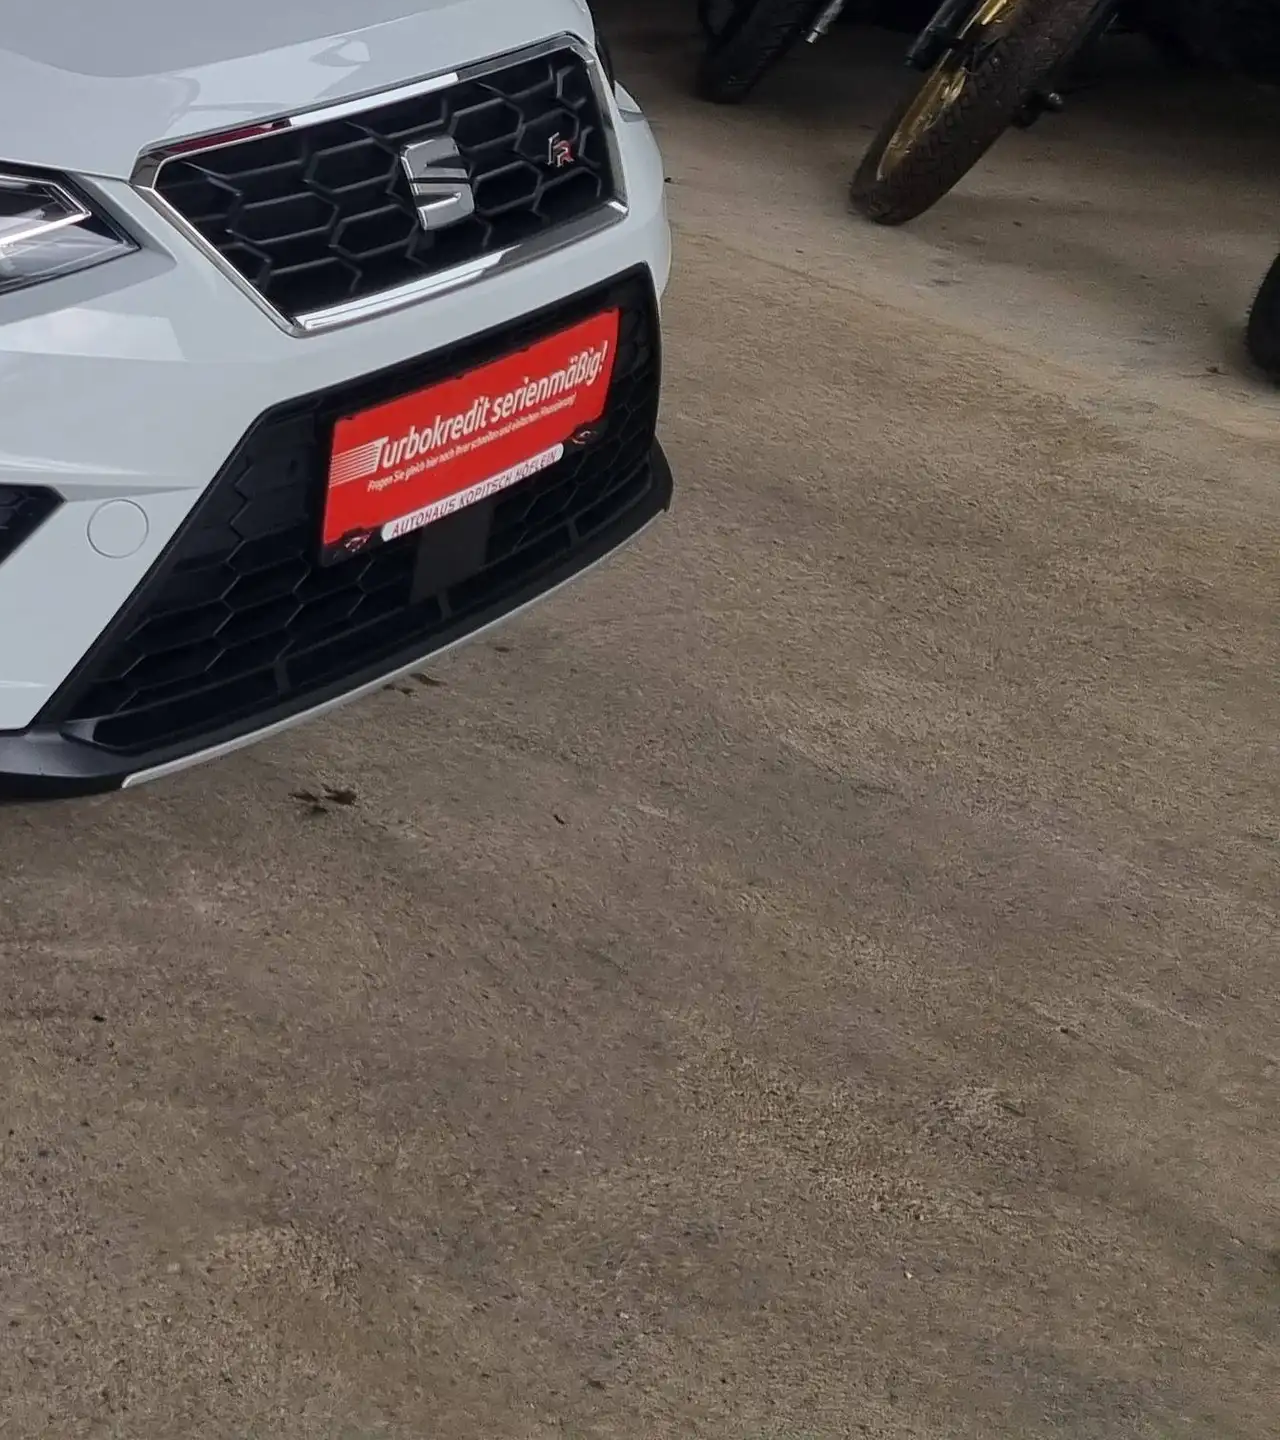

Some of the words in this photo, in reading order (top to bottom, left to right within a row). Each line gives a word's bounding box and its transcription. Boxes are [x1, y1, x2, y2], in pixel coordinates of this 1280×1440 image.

[372, 395, 491, 472] Turbokredit
[490, 339, 609, 423] serienmäßig!
[392, 501, 456, 537] AUTOHAUS
[458, 471, 513, 508] KOPITSCH
